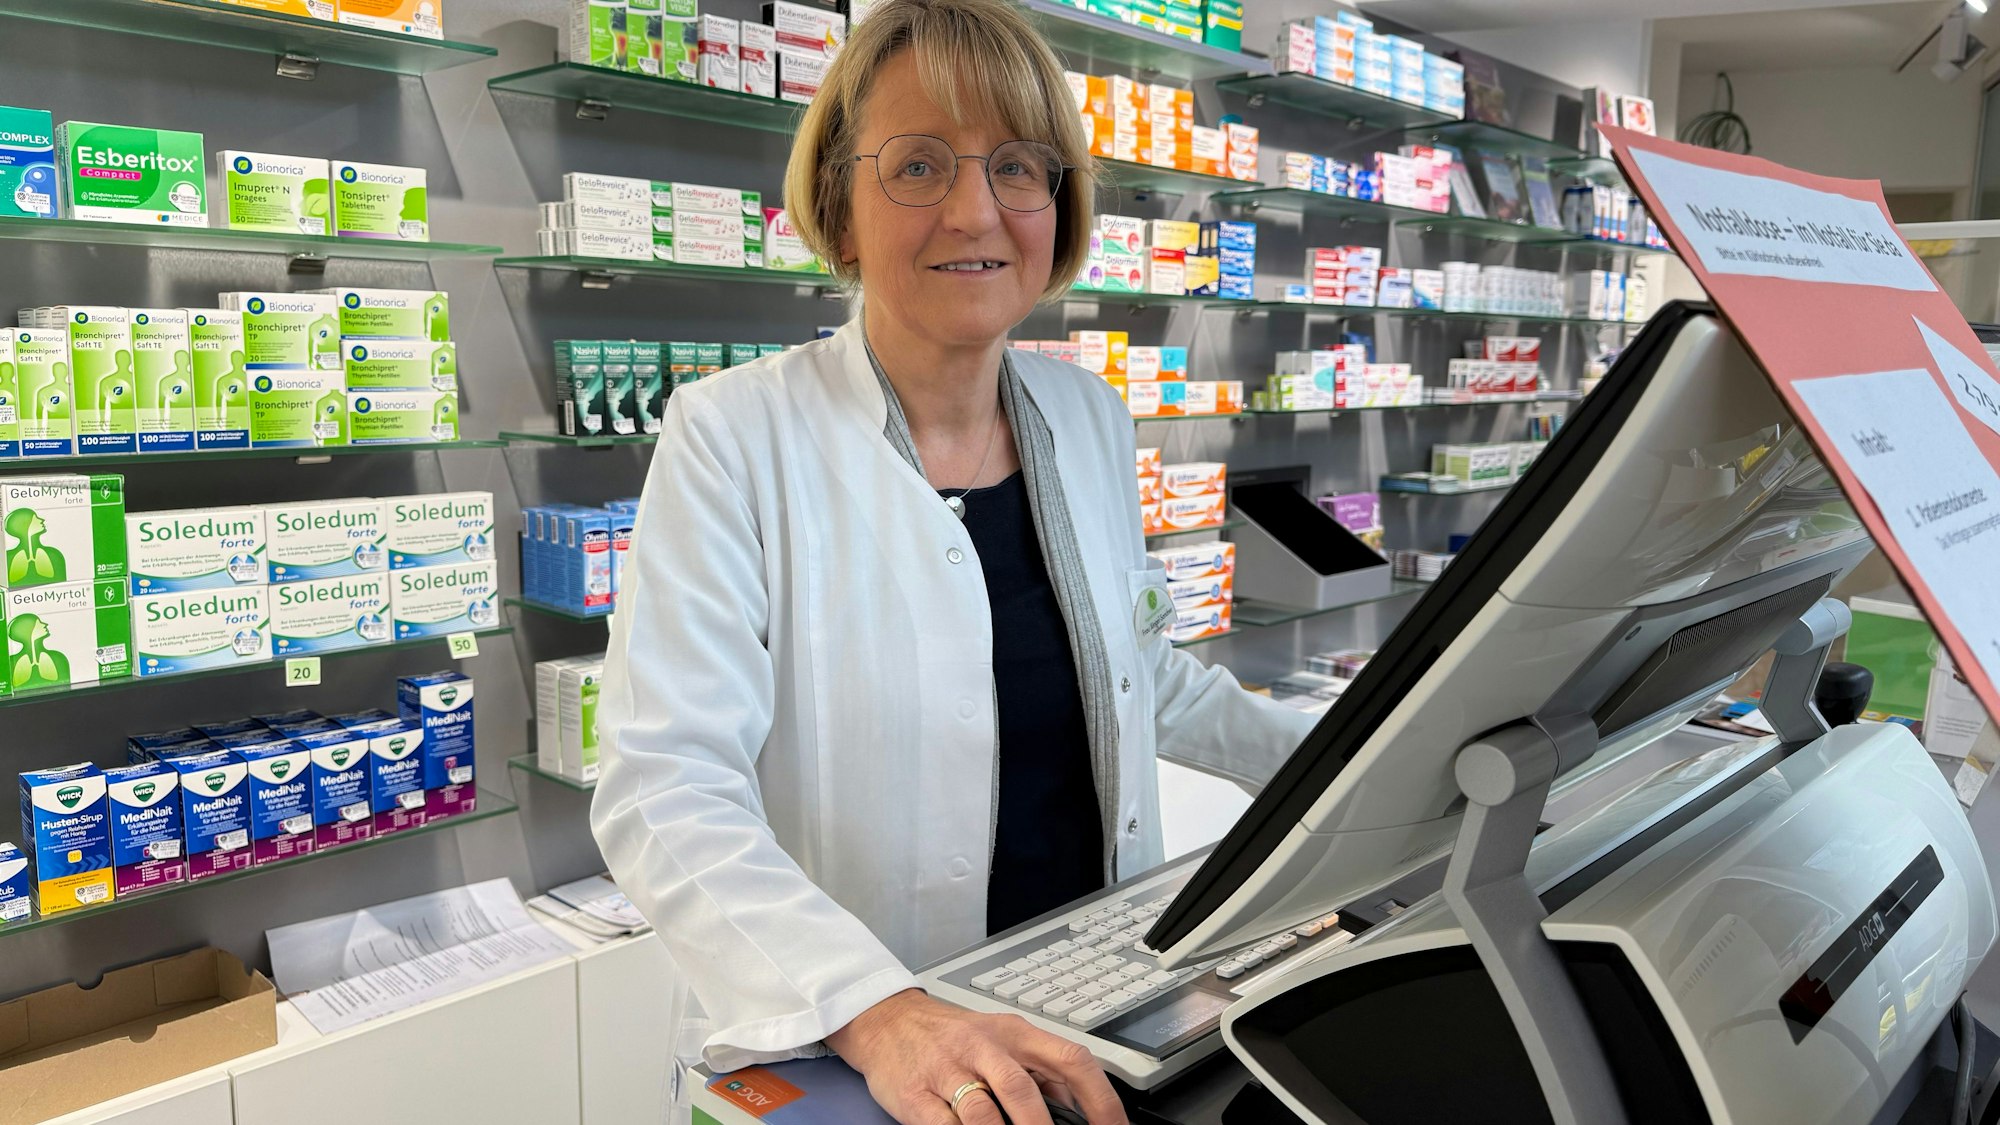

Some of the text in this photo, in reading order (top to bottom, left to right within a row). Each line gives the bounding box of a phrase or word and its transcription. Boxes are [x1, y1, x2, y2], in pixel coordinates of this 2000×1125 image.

[77, 146, 195, 174] Esberitox
[86, 168, 137, 180] Compact
[257, 163, 304, 176] Bionorica
[361, 172, 403, 184] Bionorica
[234, 182, 291, 195] Imupret N
[234, 194, 267, 204] Dragees
[341, 191, 387, 203] Tonsipret
[342, 201, 376, 211] Tabletten
[171, 214, 204, 224] MEDICE
[236, 215, 246, 223] 50
[342, 222, 351, 230] 50
[1686, 202, 1786, 242] Notfalldose
[1787, 216, 1815, 248] im
[1810, 222, 1857, 253] Notfall
[1848, 228, 1873, 256] für
[1867, 231, 1888, 259] Sie
[1881, 234, 1903, 261] da
[269, 302, 314, 312] Bionorica
[365, 298, 406, 307] Bionorica
[91, 314, 126, 324] Bionorica
[152, 316, 184, 324] Bionorica
[344, 312, 389, 320] Bronchipret
[247, 323, 303, 332] Bronchipret
[75, 332, 121, 340] Bronchipret
[136, 332, 181, 341] Bronchipret
[195, 333, 237, 341] Bronchipret
[19, 347, 59, 355] Bronchipret
[372, 349, 413, 358] Bionorica
[249, 354, 260, 362] 20
[351, 364, 396, 372] Bronchipret
[277, 380, 321, 389] Bionorica
[255, 401, 309, 410] Bronchipret
[375, 401, 416, 410] Bionorica
[355, 416, 399, 424] Bronchipret
[82, 437, 99, 445] 100
[143, 435, 158, 443] 100
[200, 433, 216, 441] 100
[256, 432, 267, 440] 20
[11, 484, 83, 499] GeloMyrtol
[395, 502, 484, 522] Soledum
[276, 510, 377, 532] Soledum
[458, 520, 485, 528] forte
[139, 518, 254, 542] Soledum
[347, 529, 377, 538] forte
[221, 538, 255, 548] forte
[401, 569, 488, 592] Soledum
[279, 581, 379, 605] Soledum
[462, 586, 488, 595] forte
[13, 588, 86, 604] GeloMyrtol
[69, 600, 87, 608] forte
[146, 595, 258, 622] Soledum
[350, 599, 380, 609] forte
[225, 613, 259, 624] forte
[455, 639, 471, 652] 50
[101, 665, 111, 673] 20
[293, 667, 311, 680] 20
[426, 710, 471, 728] MediNait
[378, 758, 420, 776] MediNait
[206, 778, 225, 786] WICK
[320, 769, 365, 787] MediNait
[59, 791, 82, 801] WICK
[135, 787, 154, 796] WICK
[259, 782, 306, 800] MediNait
[193, 795, 243, 814] MediNait
[120, 806, 173, 824] MediNait
[41, 813, 104, 832] Husten-Sirup
[50, 823, 96, 838] gegen Reizhusten
[60, 830, 87, 841] mit Honig
[1858, 918, 1881, 952] ADG
[737, 1086, 773, 1108] ADG
